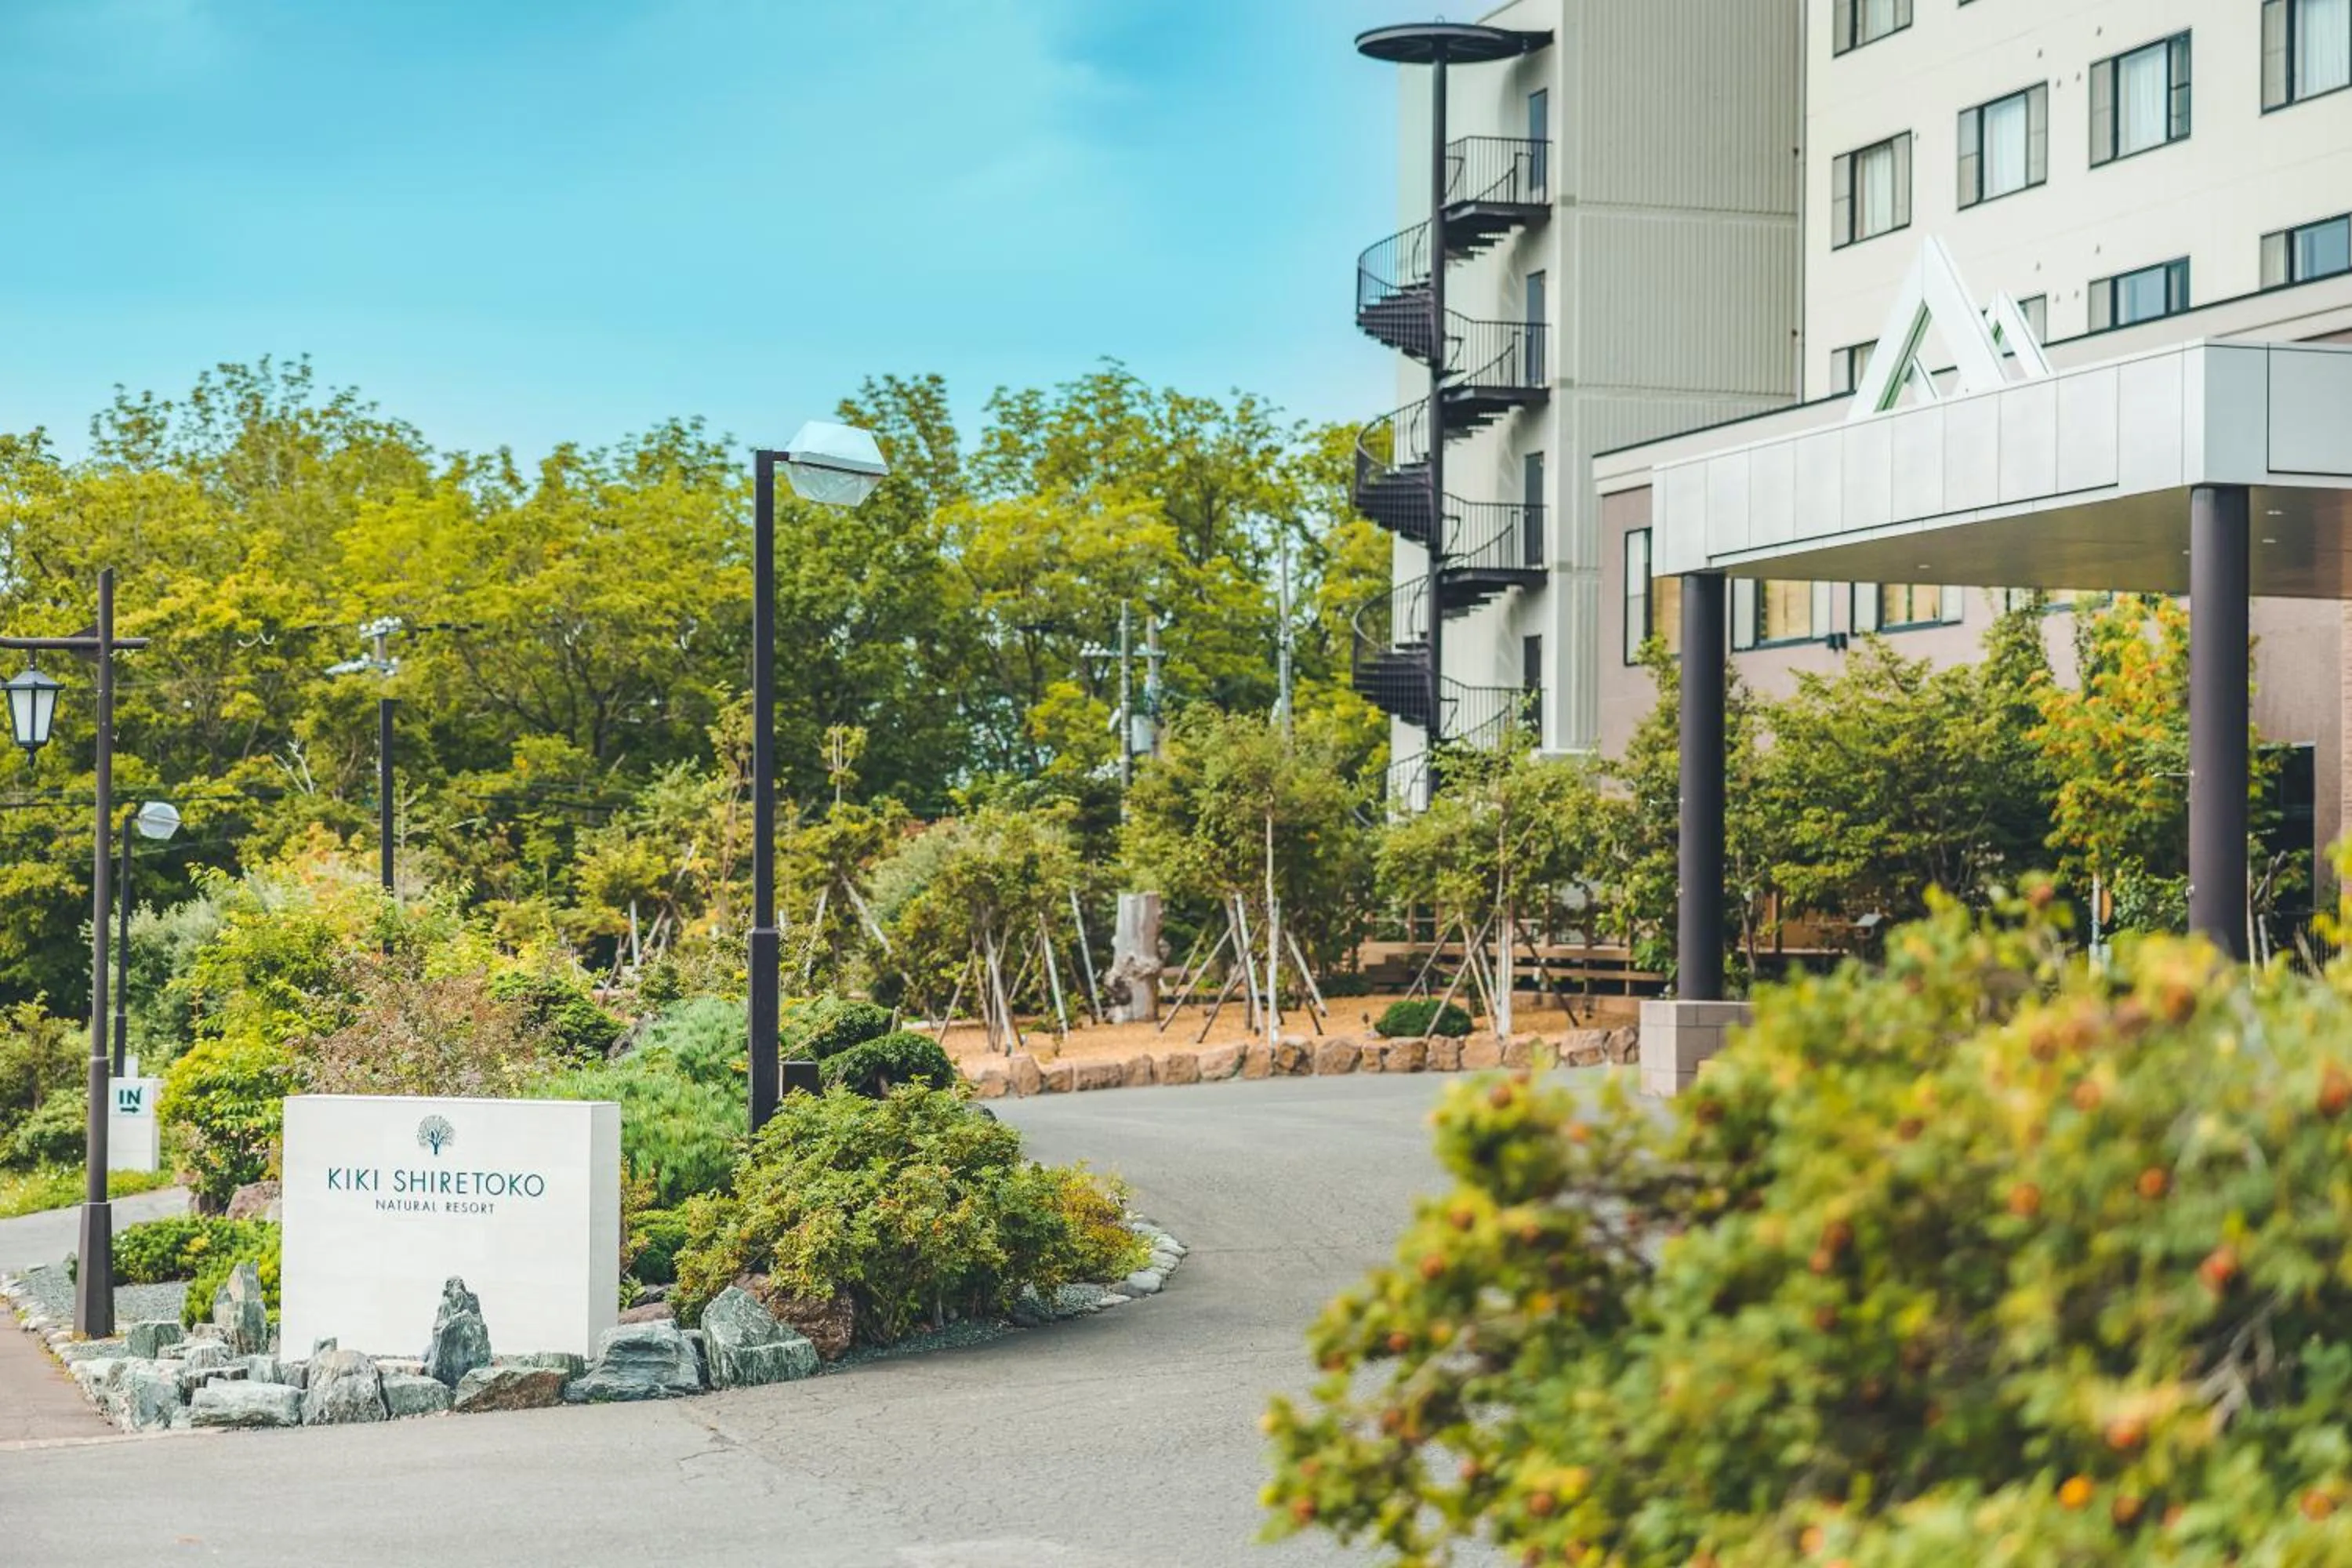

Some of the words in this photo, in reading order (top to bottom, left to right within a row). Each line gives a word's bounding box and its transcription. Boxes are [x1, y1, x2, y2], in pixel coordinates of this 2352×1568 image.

[119, 1088, 141, 1104] IN
[328, 1167, 379, 1191] KIKI
[393, 1169, 545, 1197] SHIRETOKO
[376, 1199, 437, 1211] NATURAL
[445, 1202, 495, 1214] RESORT
